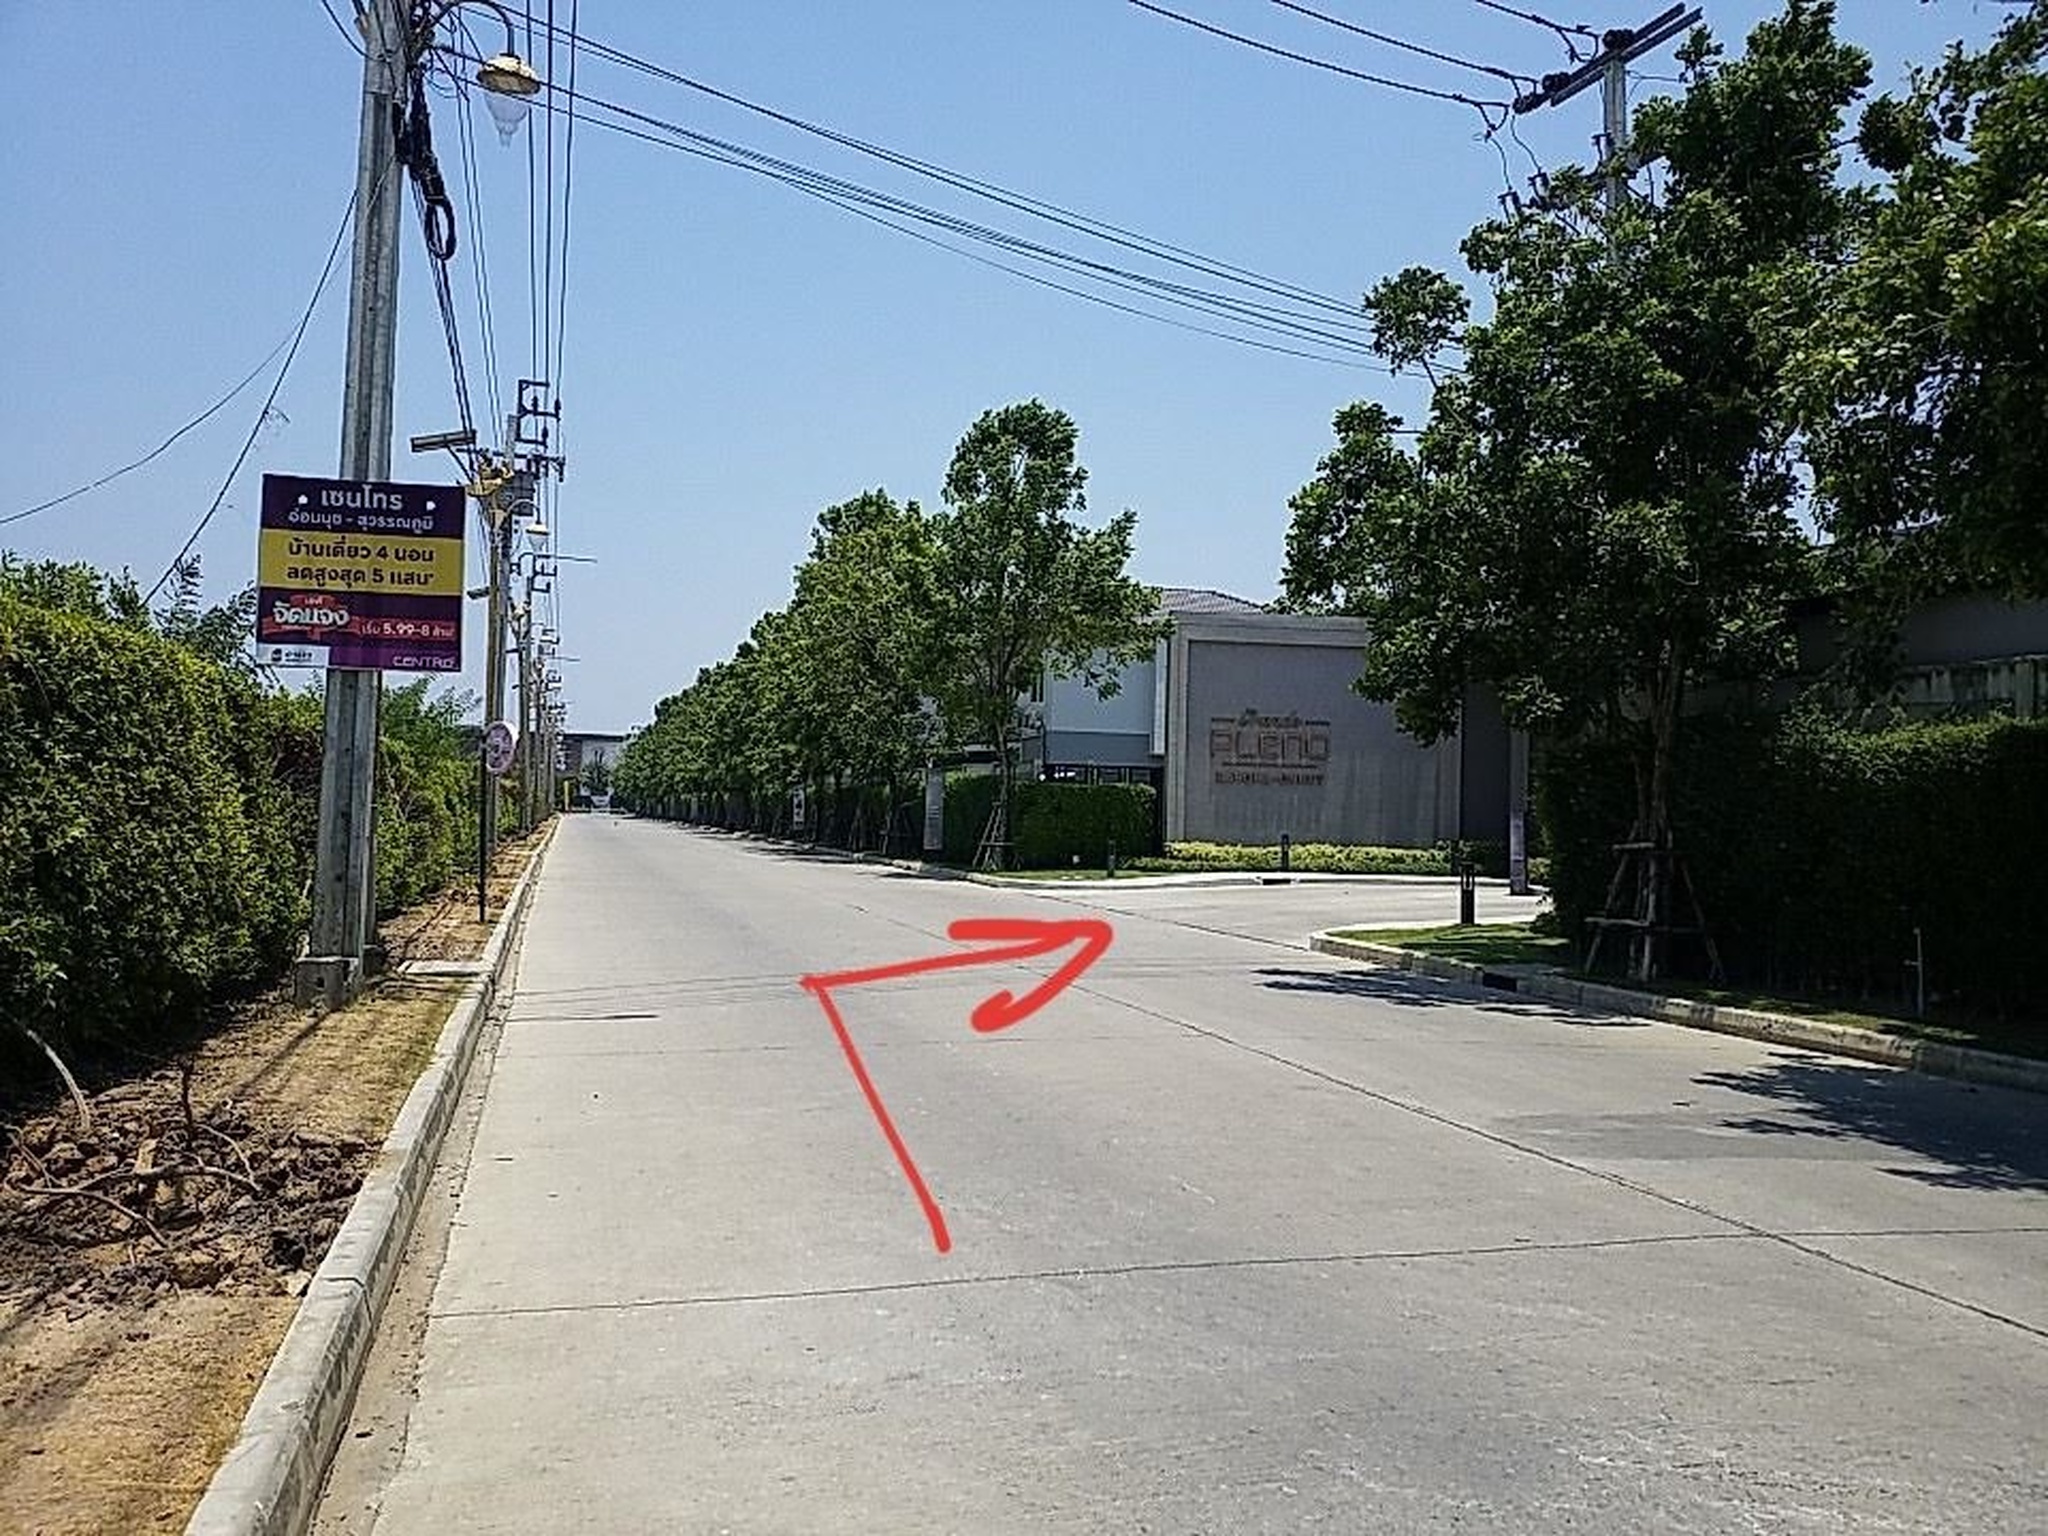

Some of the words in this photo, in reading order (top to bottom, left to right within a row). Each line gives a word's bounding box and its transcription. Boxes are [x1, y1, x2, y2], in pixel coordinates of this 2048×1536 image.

[288, 507, 342, 529] อ่อนนุช
[357, 514, 434, 533] สุวรรณภูมิ
[290, 537, 371, 559] บ้านเดี่ยว
[375, 546, 388, 560] 4
[394, 548, 434, 562] นอน
[287, 566, 367, 588] ลดสูงสุด
[372, 569, 384, 583] 5
